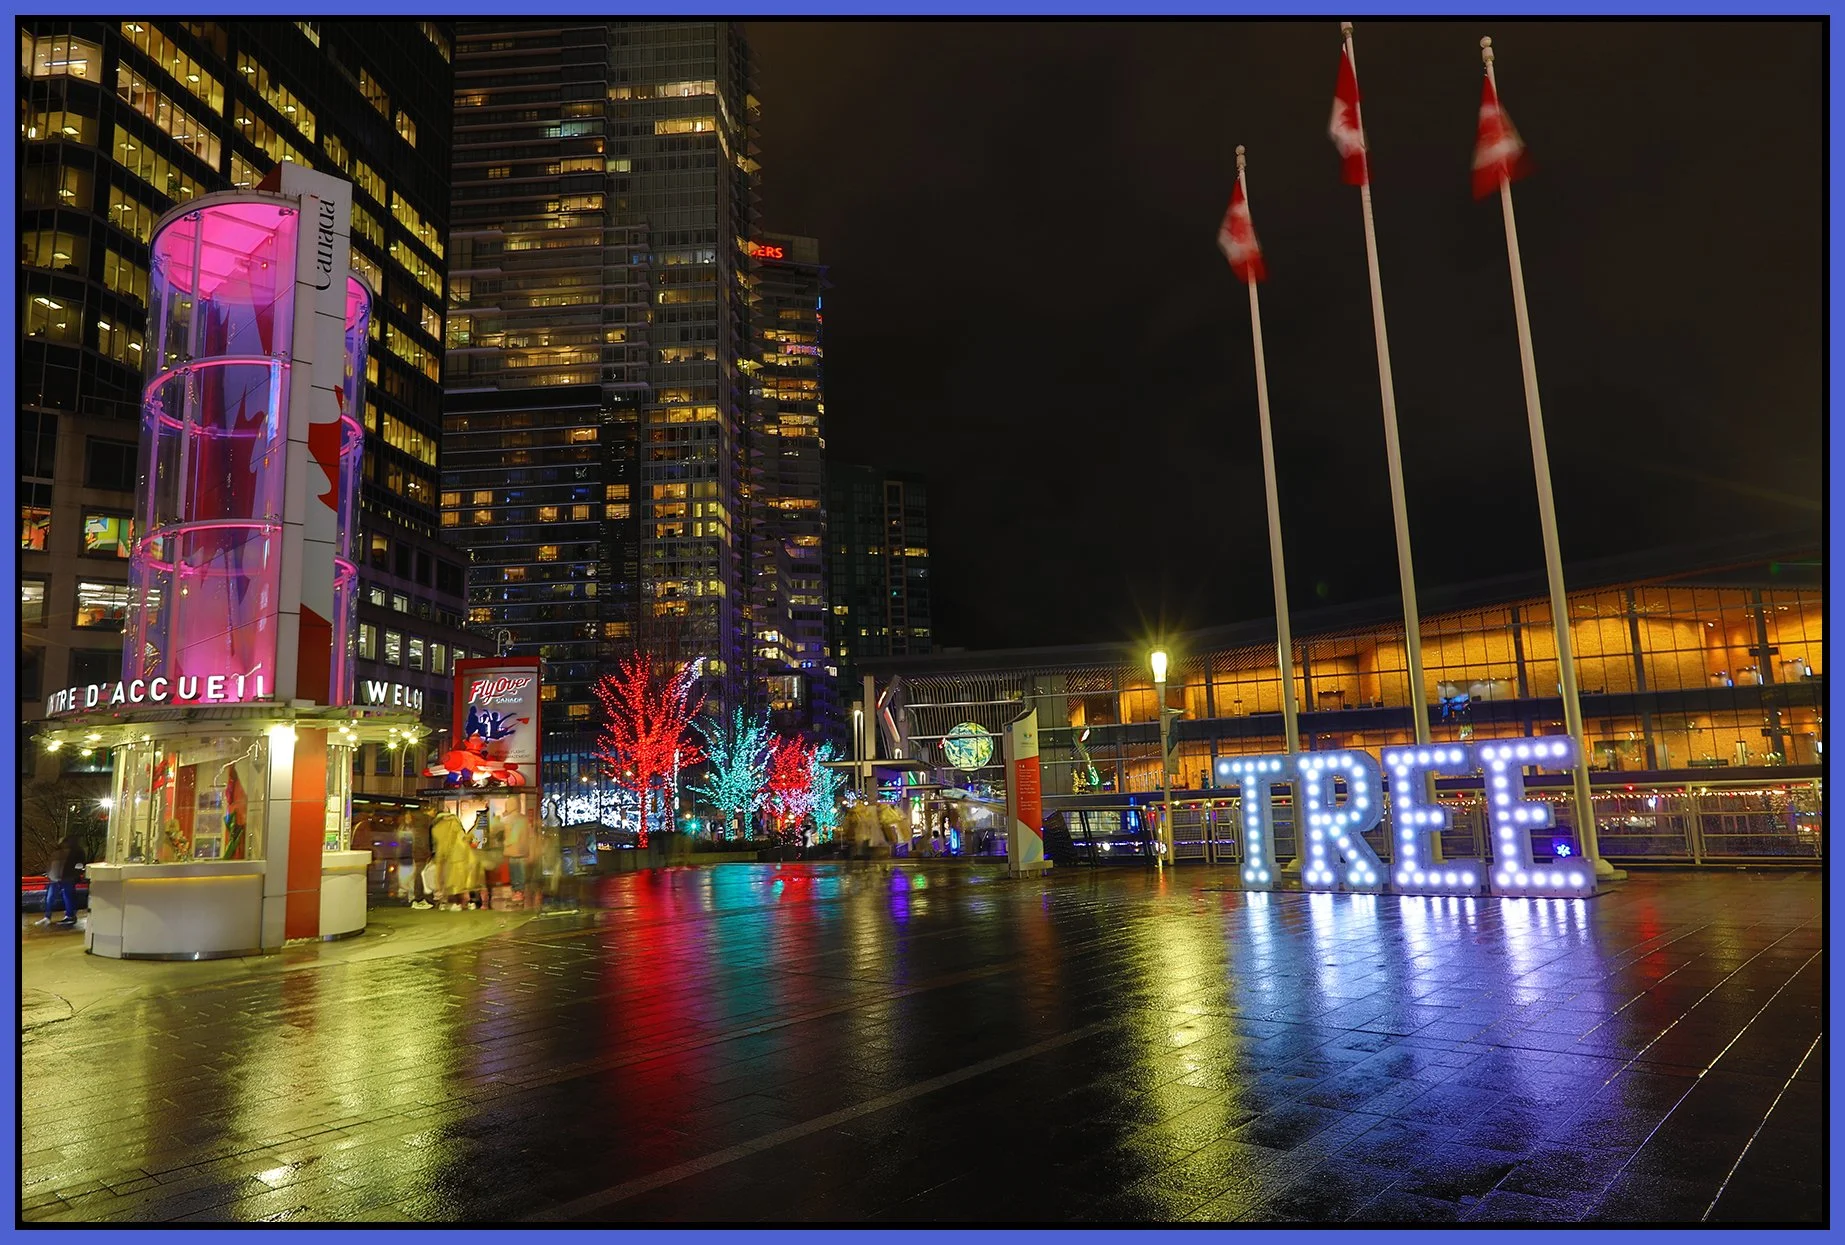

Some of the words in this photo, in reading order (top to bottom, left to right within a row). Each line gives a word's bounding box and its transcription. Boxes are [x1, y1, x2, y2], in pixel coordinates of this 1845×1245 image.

[315, 199, 336, 291] Canada
[751, 245, 783, 259] ERS
[468, 677, 531, 705] FlyOver
[1215, 734, 1597, 898] TREE
